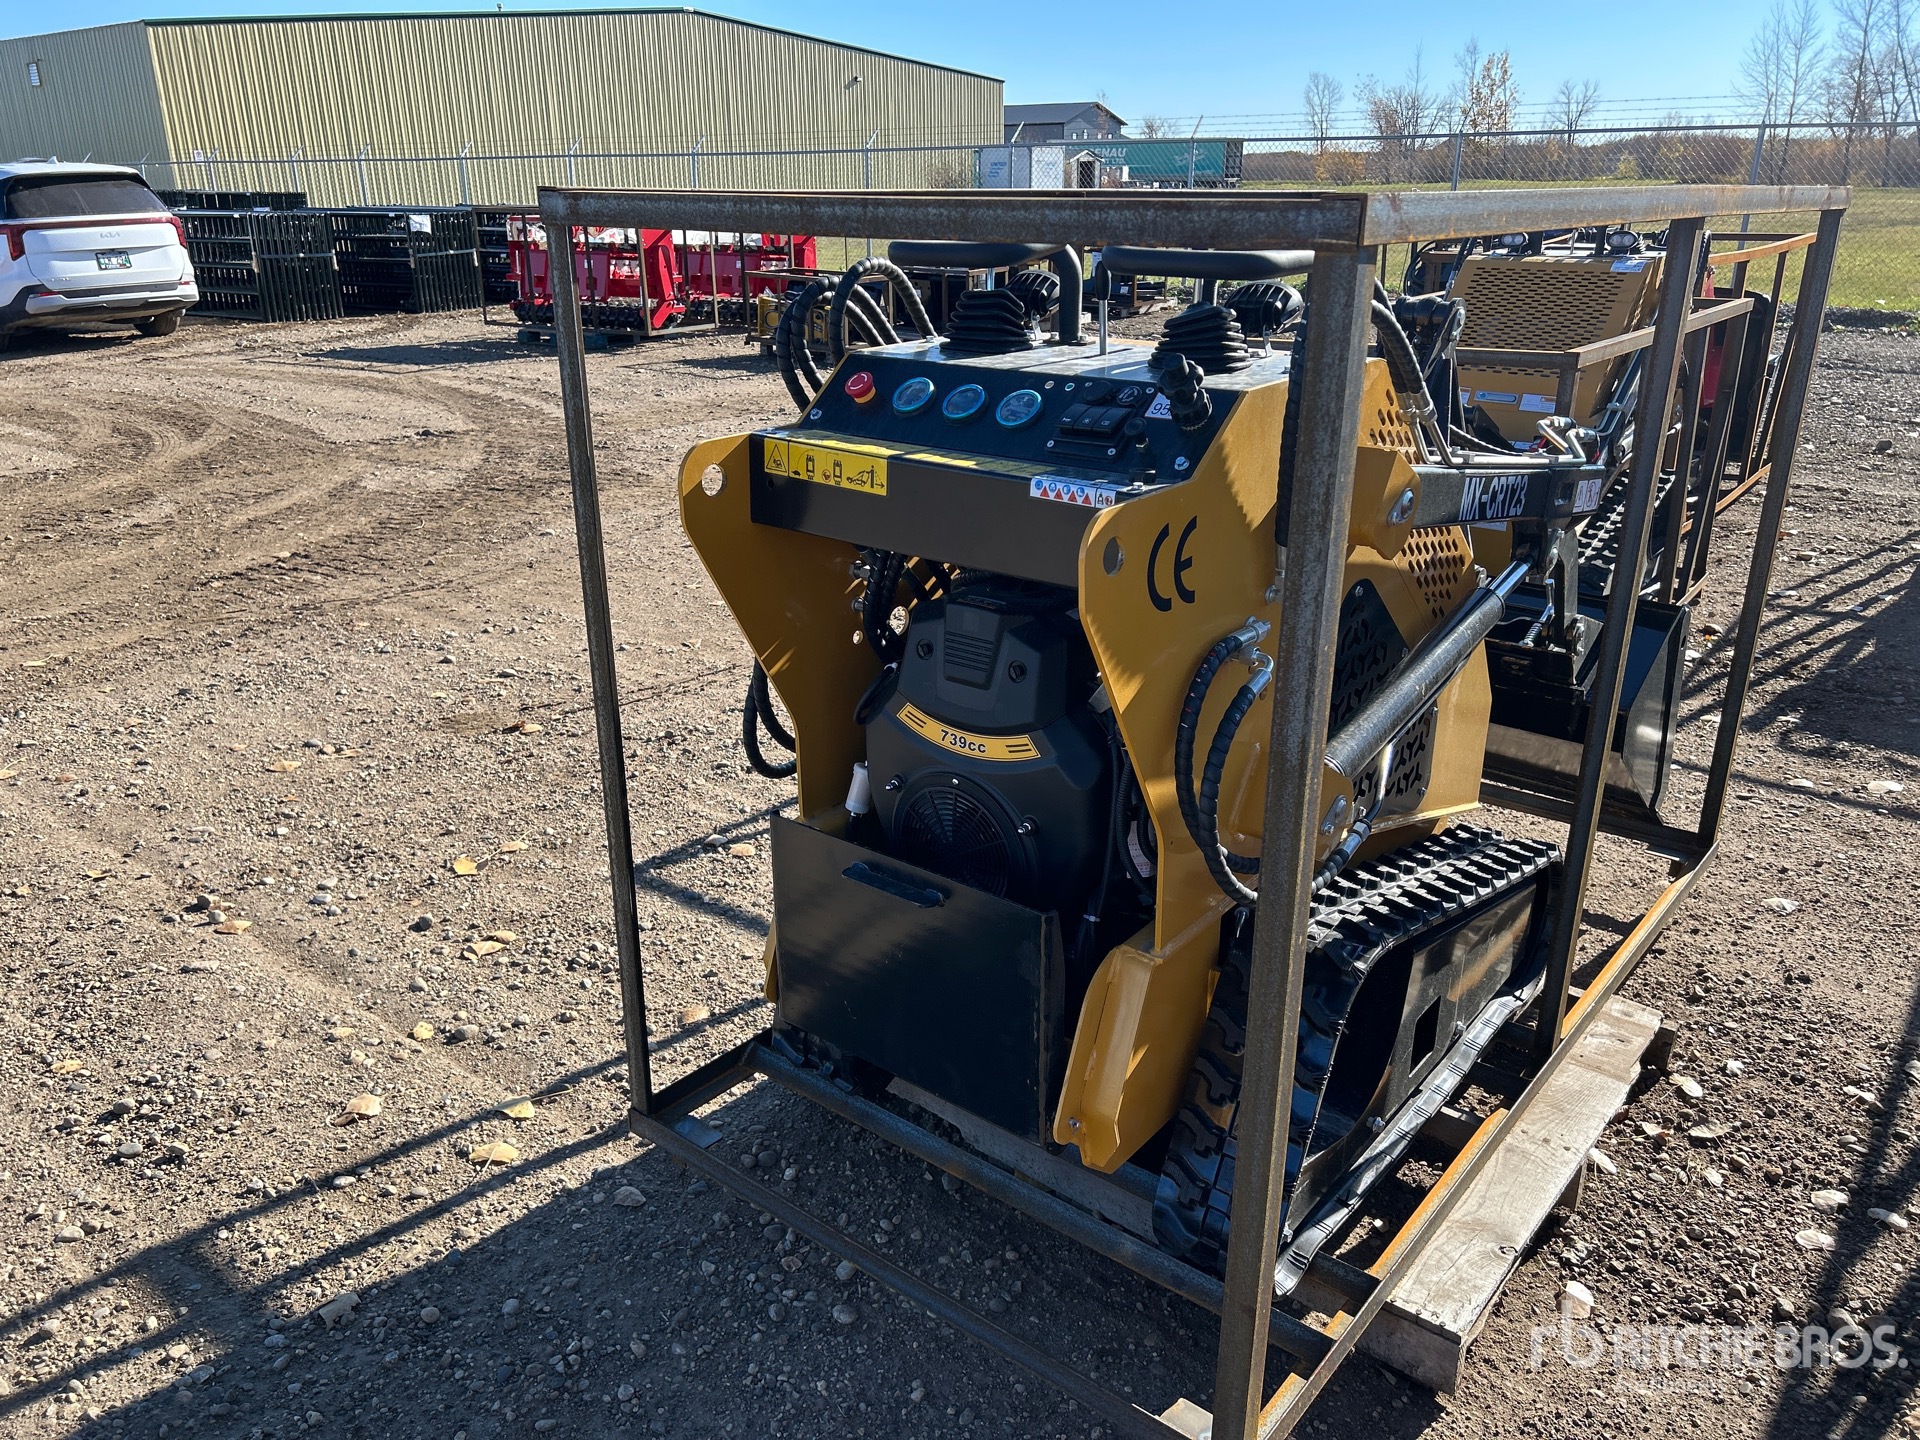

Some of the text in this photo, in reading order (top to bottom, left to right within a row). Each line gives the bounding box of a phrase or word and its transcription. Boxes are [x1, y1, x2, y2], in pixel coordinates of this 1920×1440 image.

[1089, 147, 1127, 158] ENAU
[1151, 402, 1171, 416] 95
[1459, 475, 1529, 521] MX-CRT23
[1147, 514, 1198, 612] CE
[941, 729, 986, 754] 739cc
